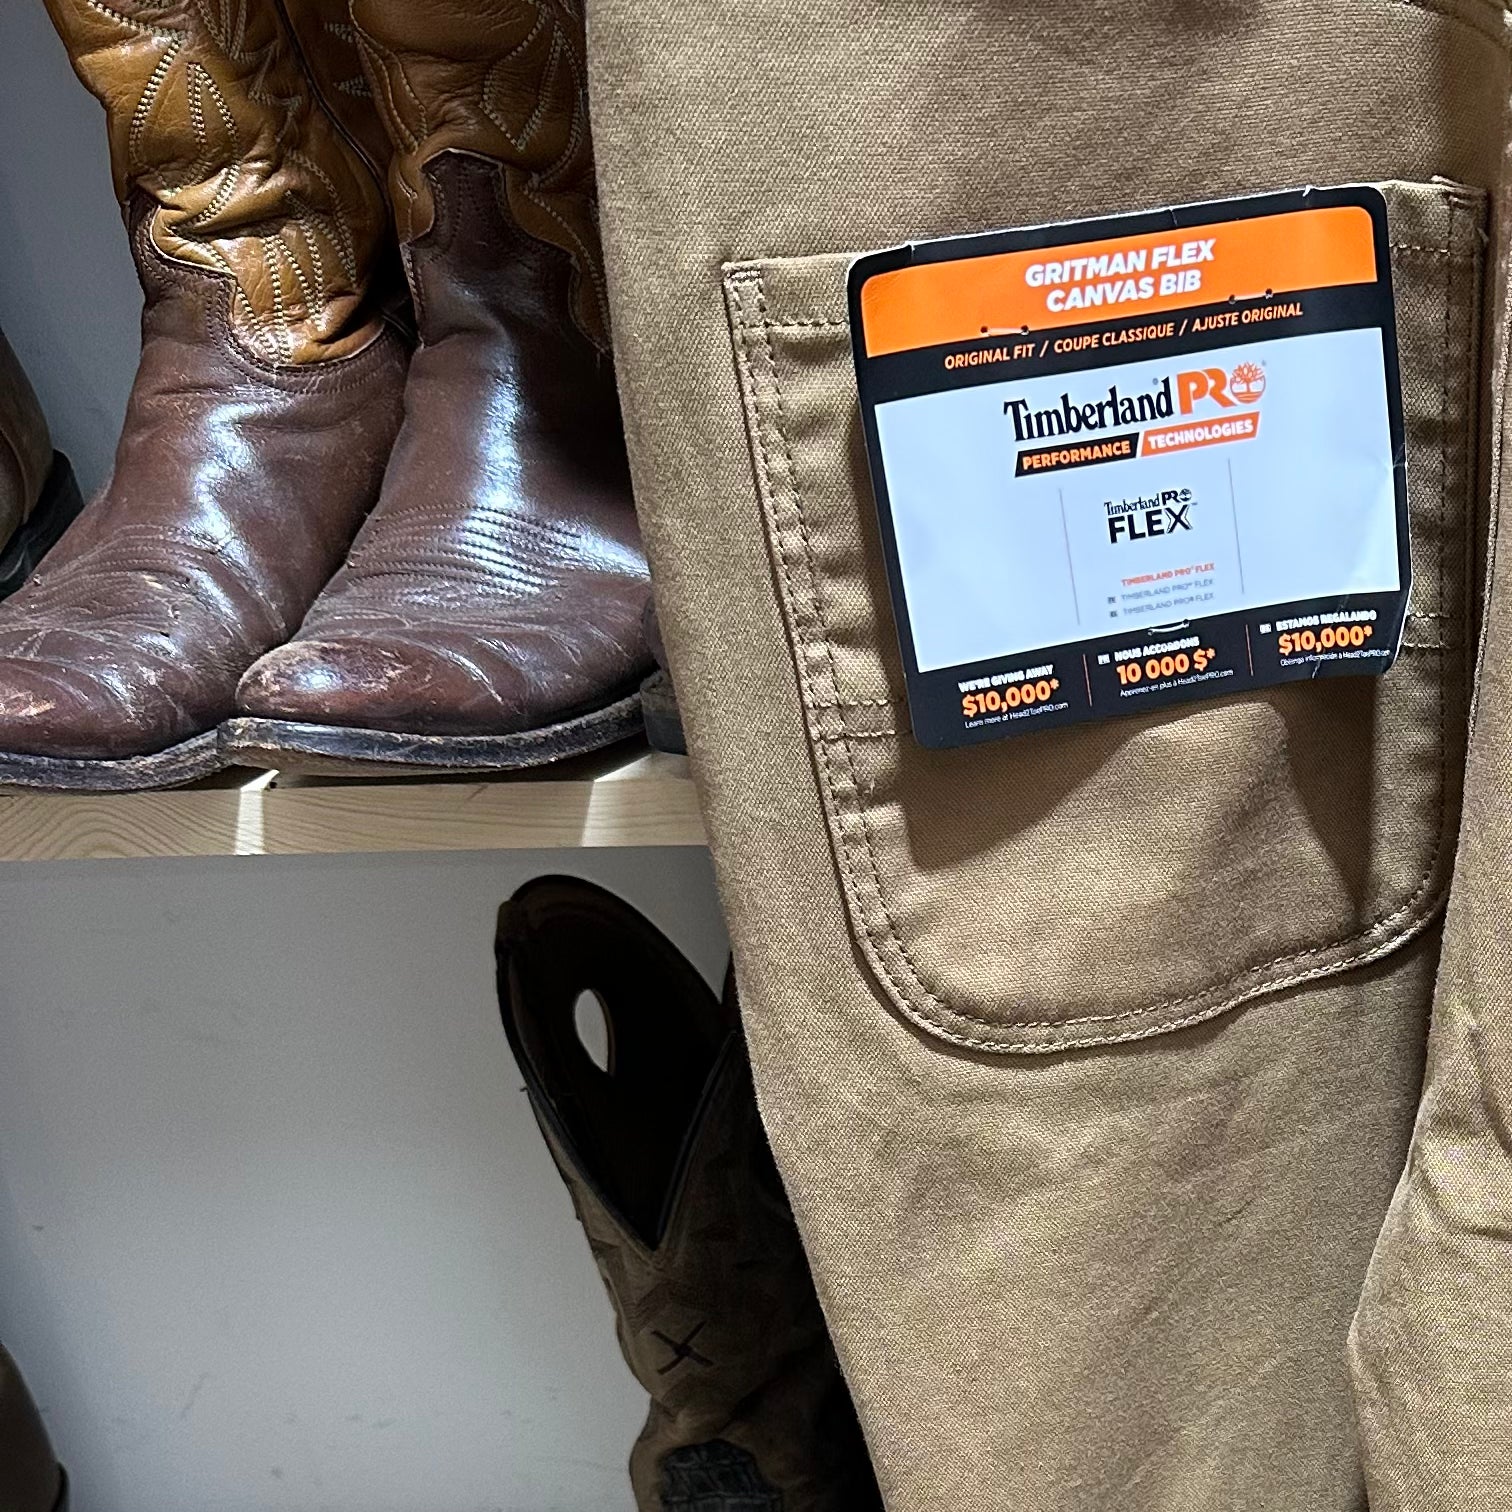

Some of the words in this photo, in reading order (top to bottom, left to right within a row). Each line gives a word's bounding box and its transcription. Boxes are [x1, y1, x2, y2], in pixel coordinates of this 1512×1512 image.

[1025, 249, 1147, 287] GRITMAN
[1151, 238, 1216, 270] FLEX
[1046, 276, 1155, 312] CANVAS
[1159, 269, 1202, 296] BIB
[944, 347, 1010, 369] ORIGINAL
[1013, 343, 1036, 360] FIT
[1053, 334, 1100, 354] COUPE
[1102, 322, 1175, 347] CLASSIQUE
[1191, 311, 1240, 333] AJUSTE
[1241, 302, 1304, 324] ORIGINAL
[1003, 375, 1174, 442] Timberland
[1022, 440, 1131, 470] PERFORMANCE
[1147, 418, 1254, 450] TECHNOLOGIES
[1103, 493, 1161, 516] Timberland
[1107, 503, 1193, 545] FLEX
[1121, 570, 1174, 587] TIMBERLAND
[1195, 562, 1215, 573] FLEX
[1276, 615, 1320, 632] ESTAMOS
[1114, 647, 1142, 662] NOUS
[1142, 636, 1200, 656] ACCORDONS
[958, 677, 991, 693] WE'RE
[991, 670, 1026, 686] GIVING
[1026, 664, 1054, 679] AWAY
[1116, 662, 1142, 685] 10
[1145, 653, 1190, 679] 000
